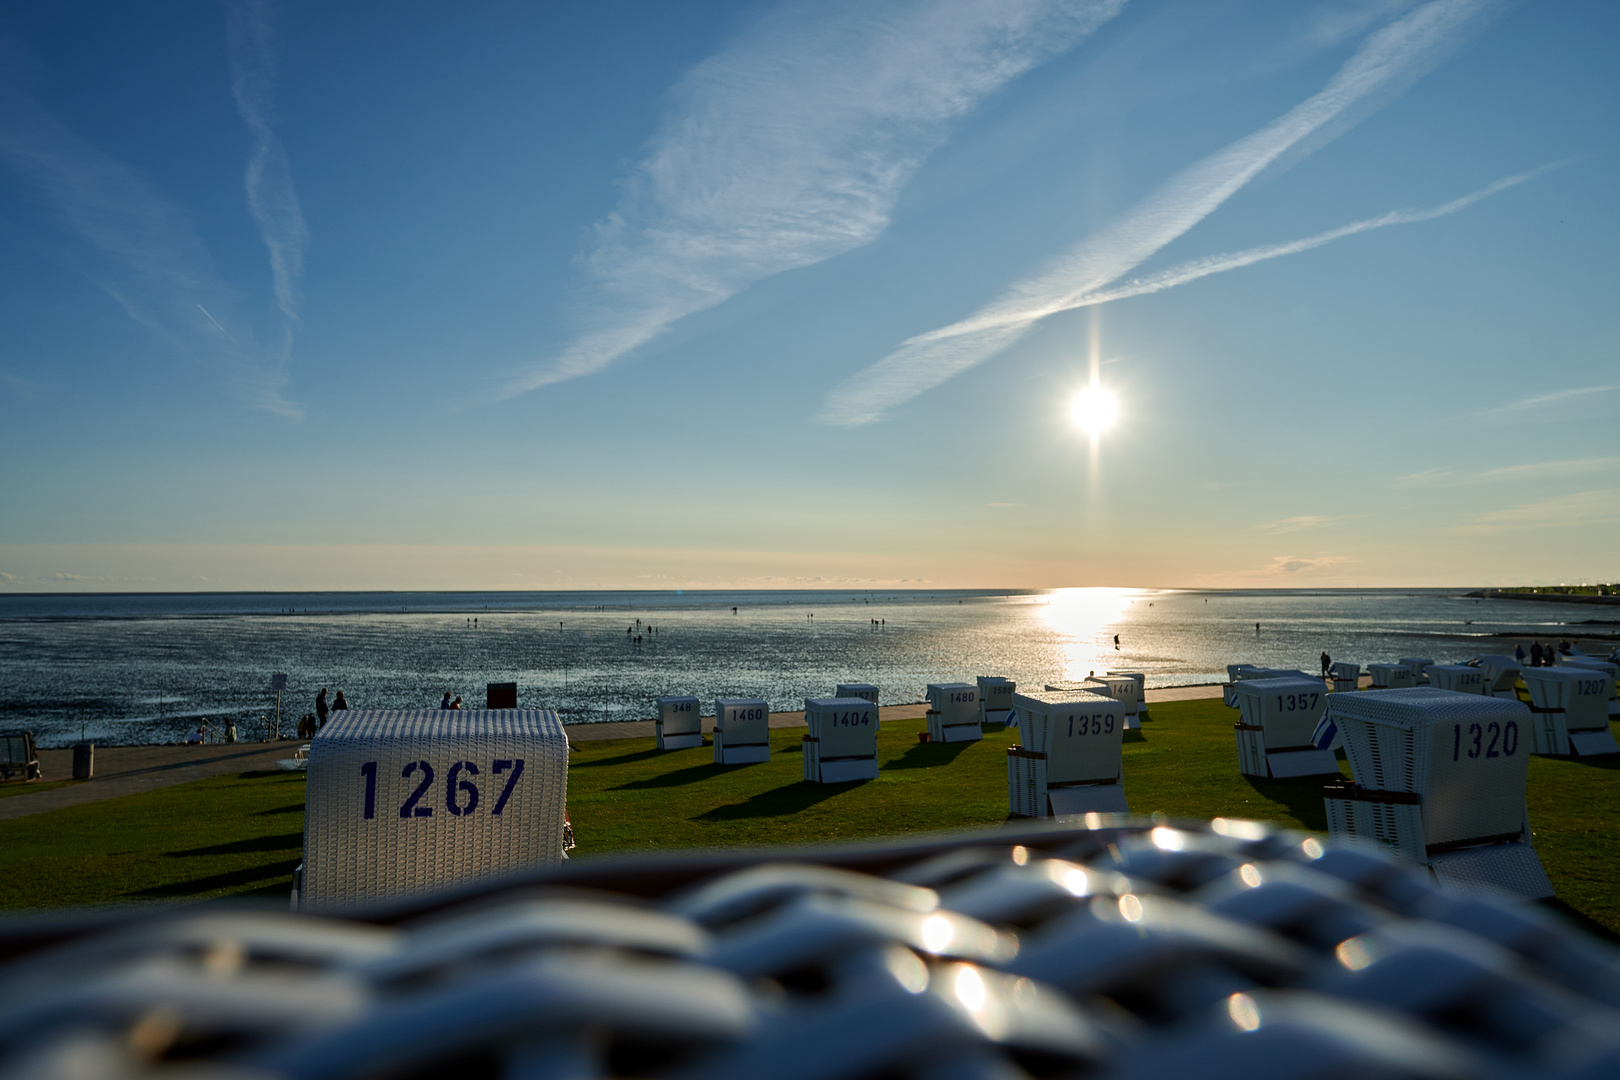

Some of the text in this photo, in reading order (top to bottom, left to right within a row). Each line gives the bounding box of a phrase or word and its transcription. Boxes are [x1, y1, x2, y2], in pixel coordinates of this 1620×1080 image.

[1461, 673, 1481, 685] 1242
[1113, 684, 1134, 695] 1441
[1578, 679, 1606, 696] 1207
[950, 692, 975, 704] 1480
[1278, 693, 1319, 712] 1357
[672, 703, 691, 713] 348
[733, 709, 763, 721] 1460
[833, 711, 869, 727] 1404
[1068, 714, 1114, 737] 1359
[1453, 720, 1518, 761] 1320
[361, 759, 525, 820] 1267
